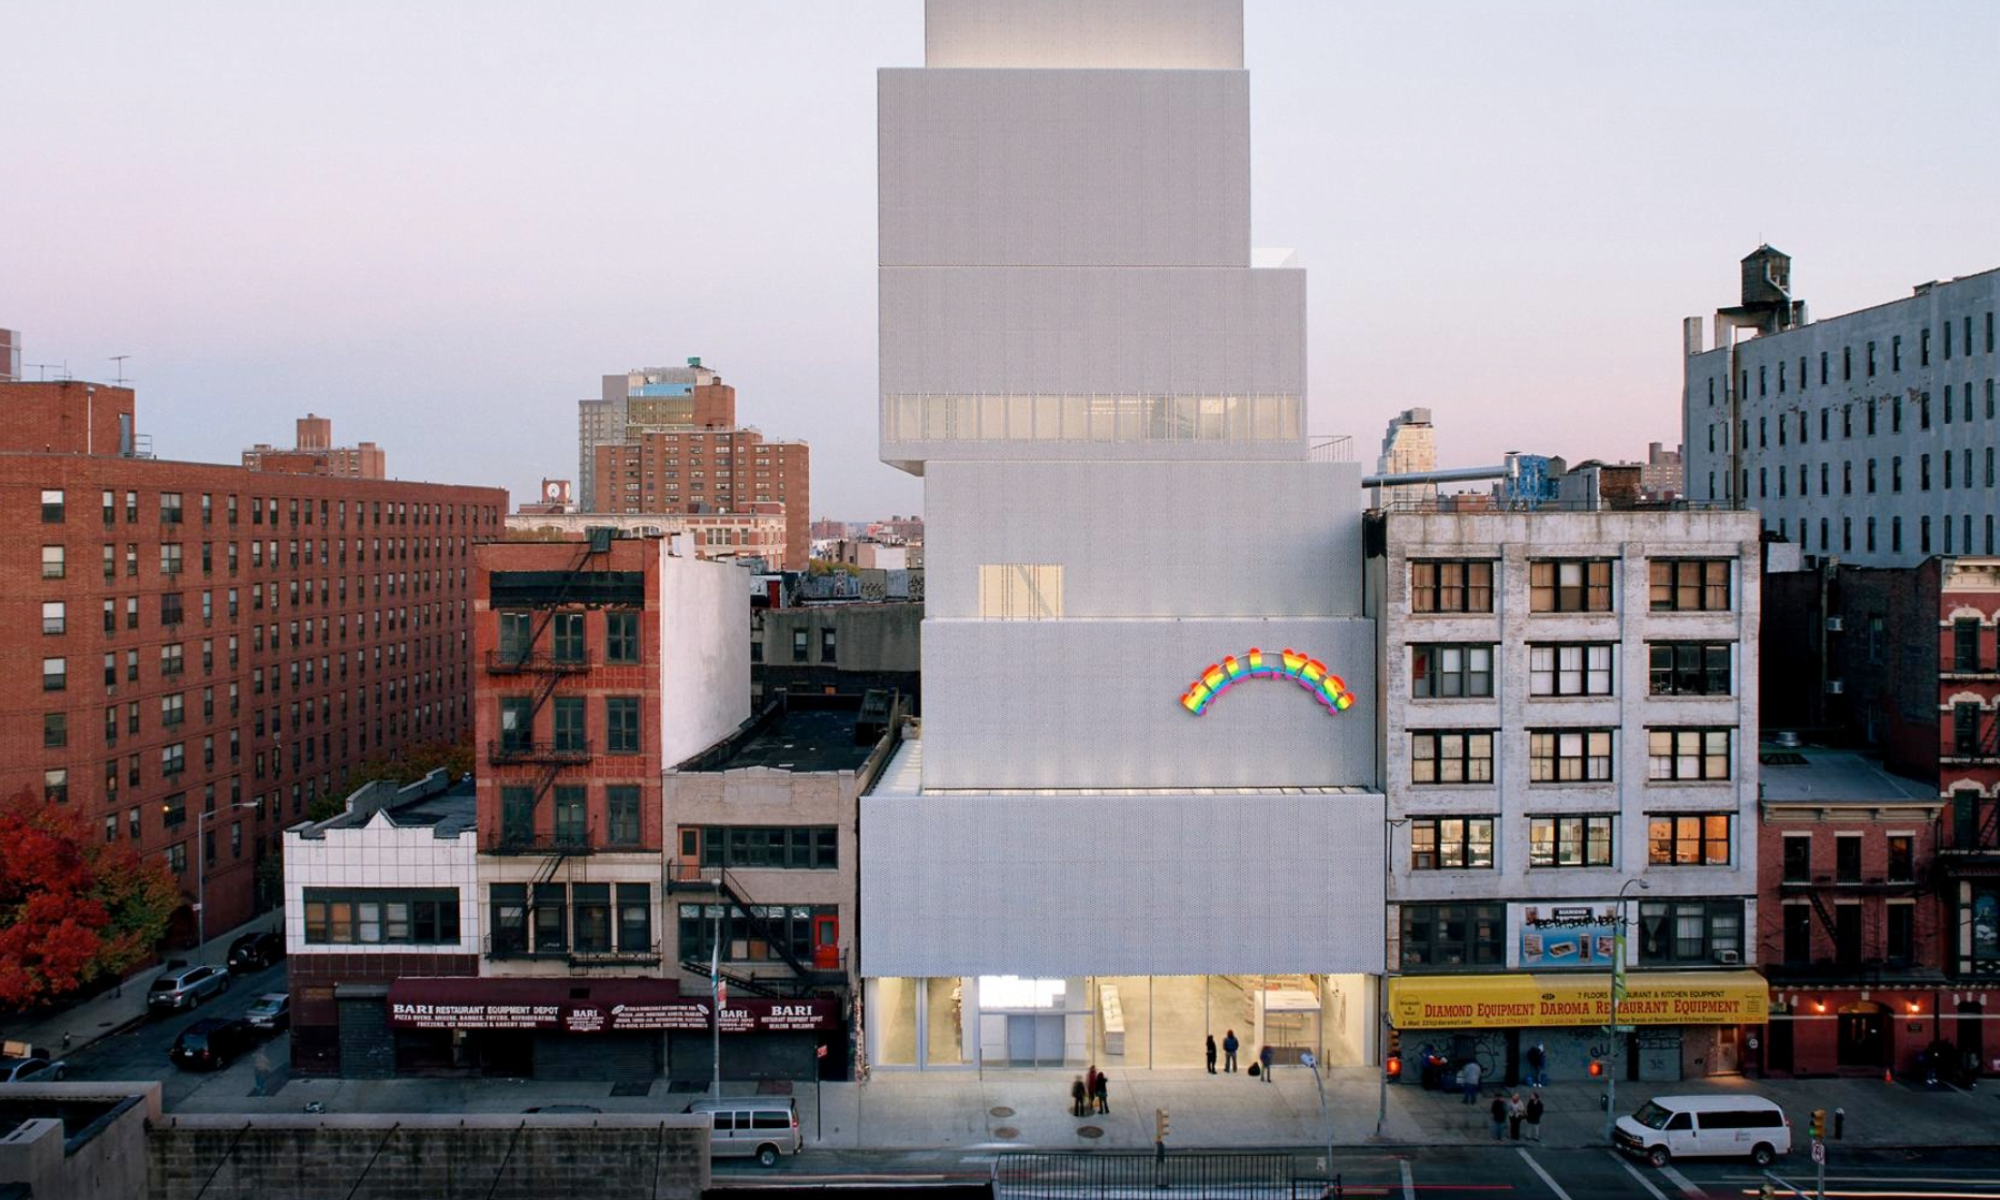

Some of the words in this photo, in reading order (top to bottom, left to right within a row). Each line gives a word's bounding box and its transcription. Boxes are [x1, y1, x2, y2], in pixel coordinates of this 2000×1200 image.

[393, 1004, 434, 1014] BARI
[435, 1006, 485, 1015] RESTAURANT
[487, 1006, 530, 1015] EQUIPMENT
[533, 1006, 559, 1015] DEPOT
[771, 1005, 812, 1016] BARI
[1596, 1000, 1668, 1014] RETAURANT
[573, 1009, 598, 1017] BARI
[720, 1010, 748, 1018] BARI
